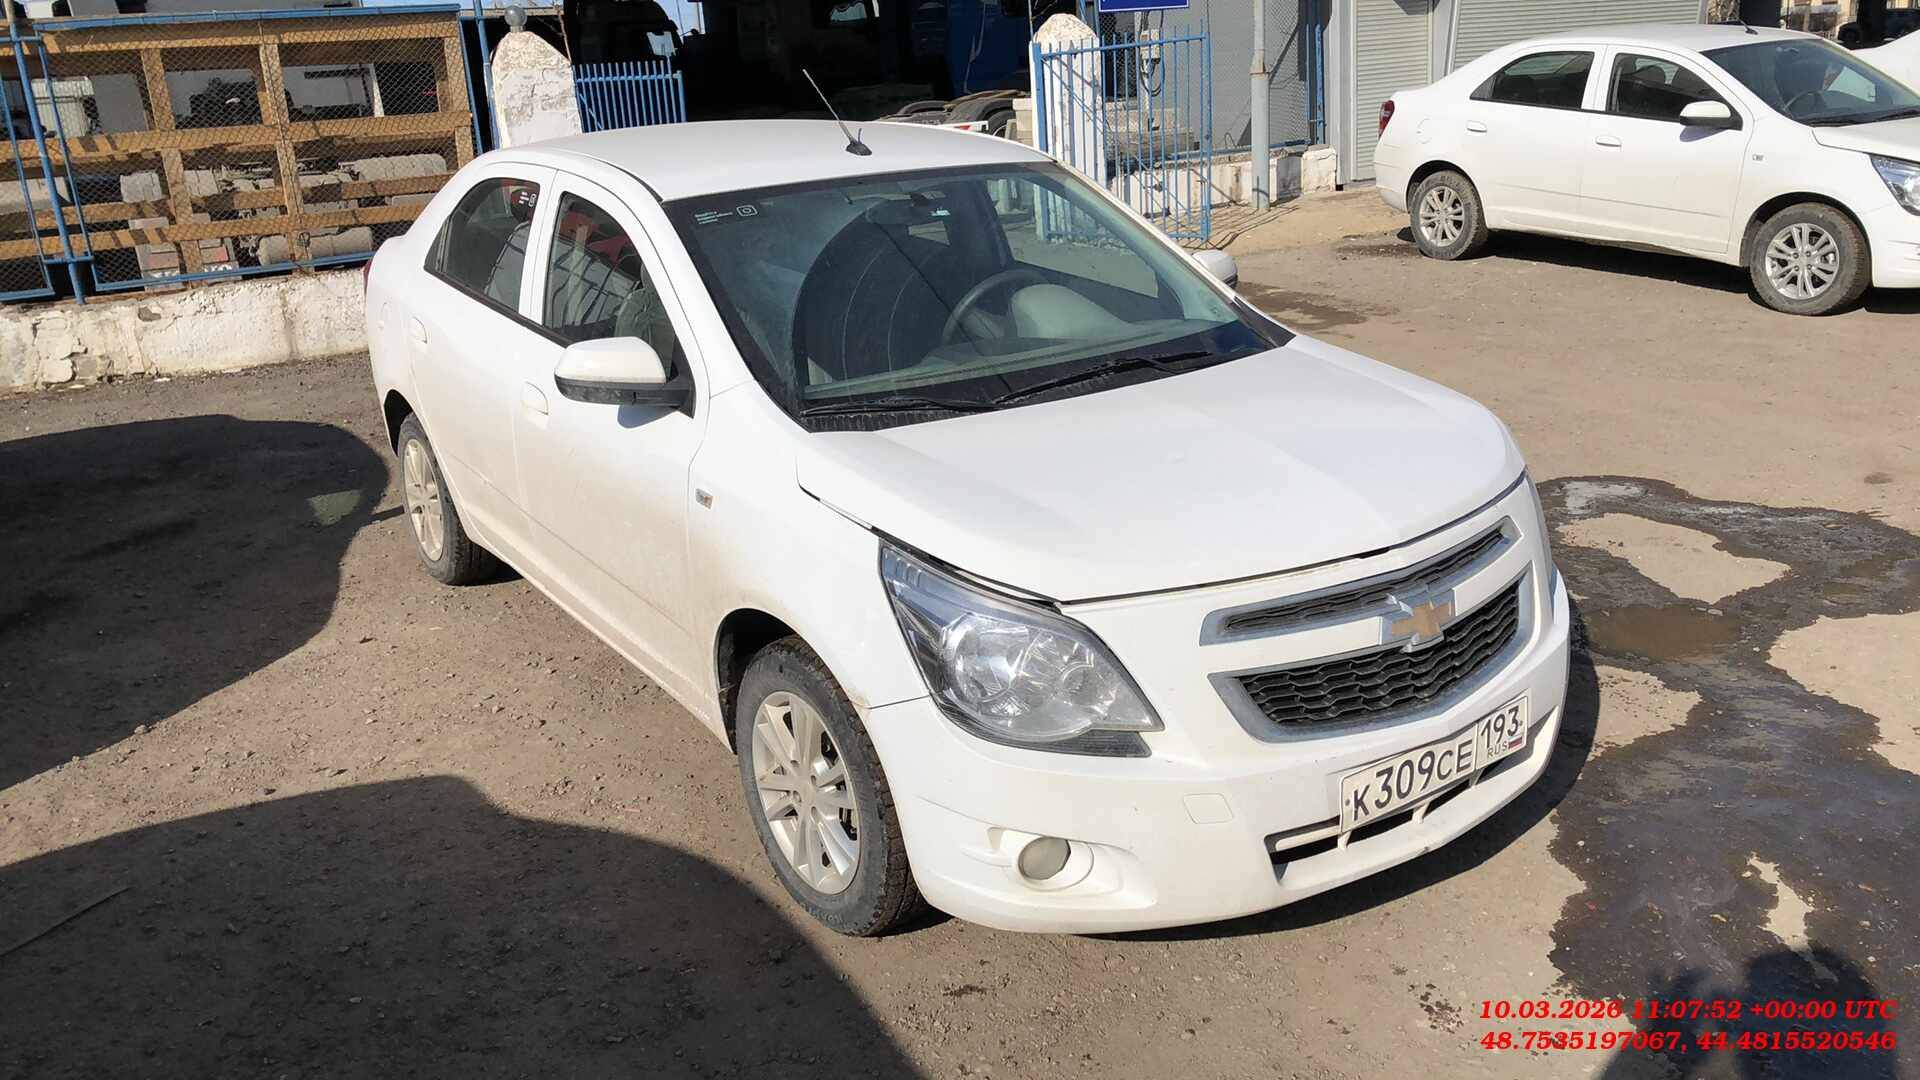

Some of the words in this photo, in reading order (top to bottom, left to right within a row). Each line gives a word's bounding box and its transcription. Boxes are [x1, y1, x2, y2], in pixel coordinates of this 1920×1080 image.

[1354, 740, 1473, 821] К309СЕ
[1481, 705, 1519, 749] 193
[1487, 740, 1508, 758] RUS
